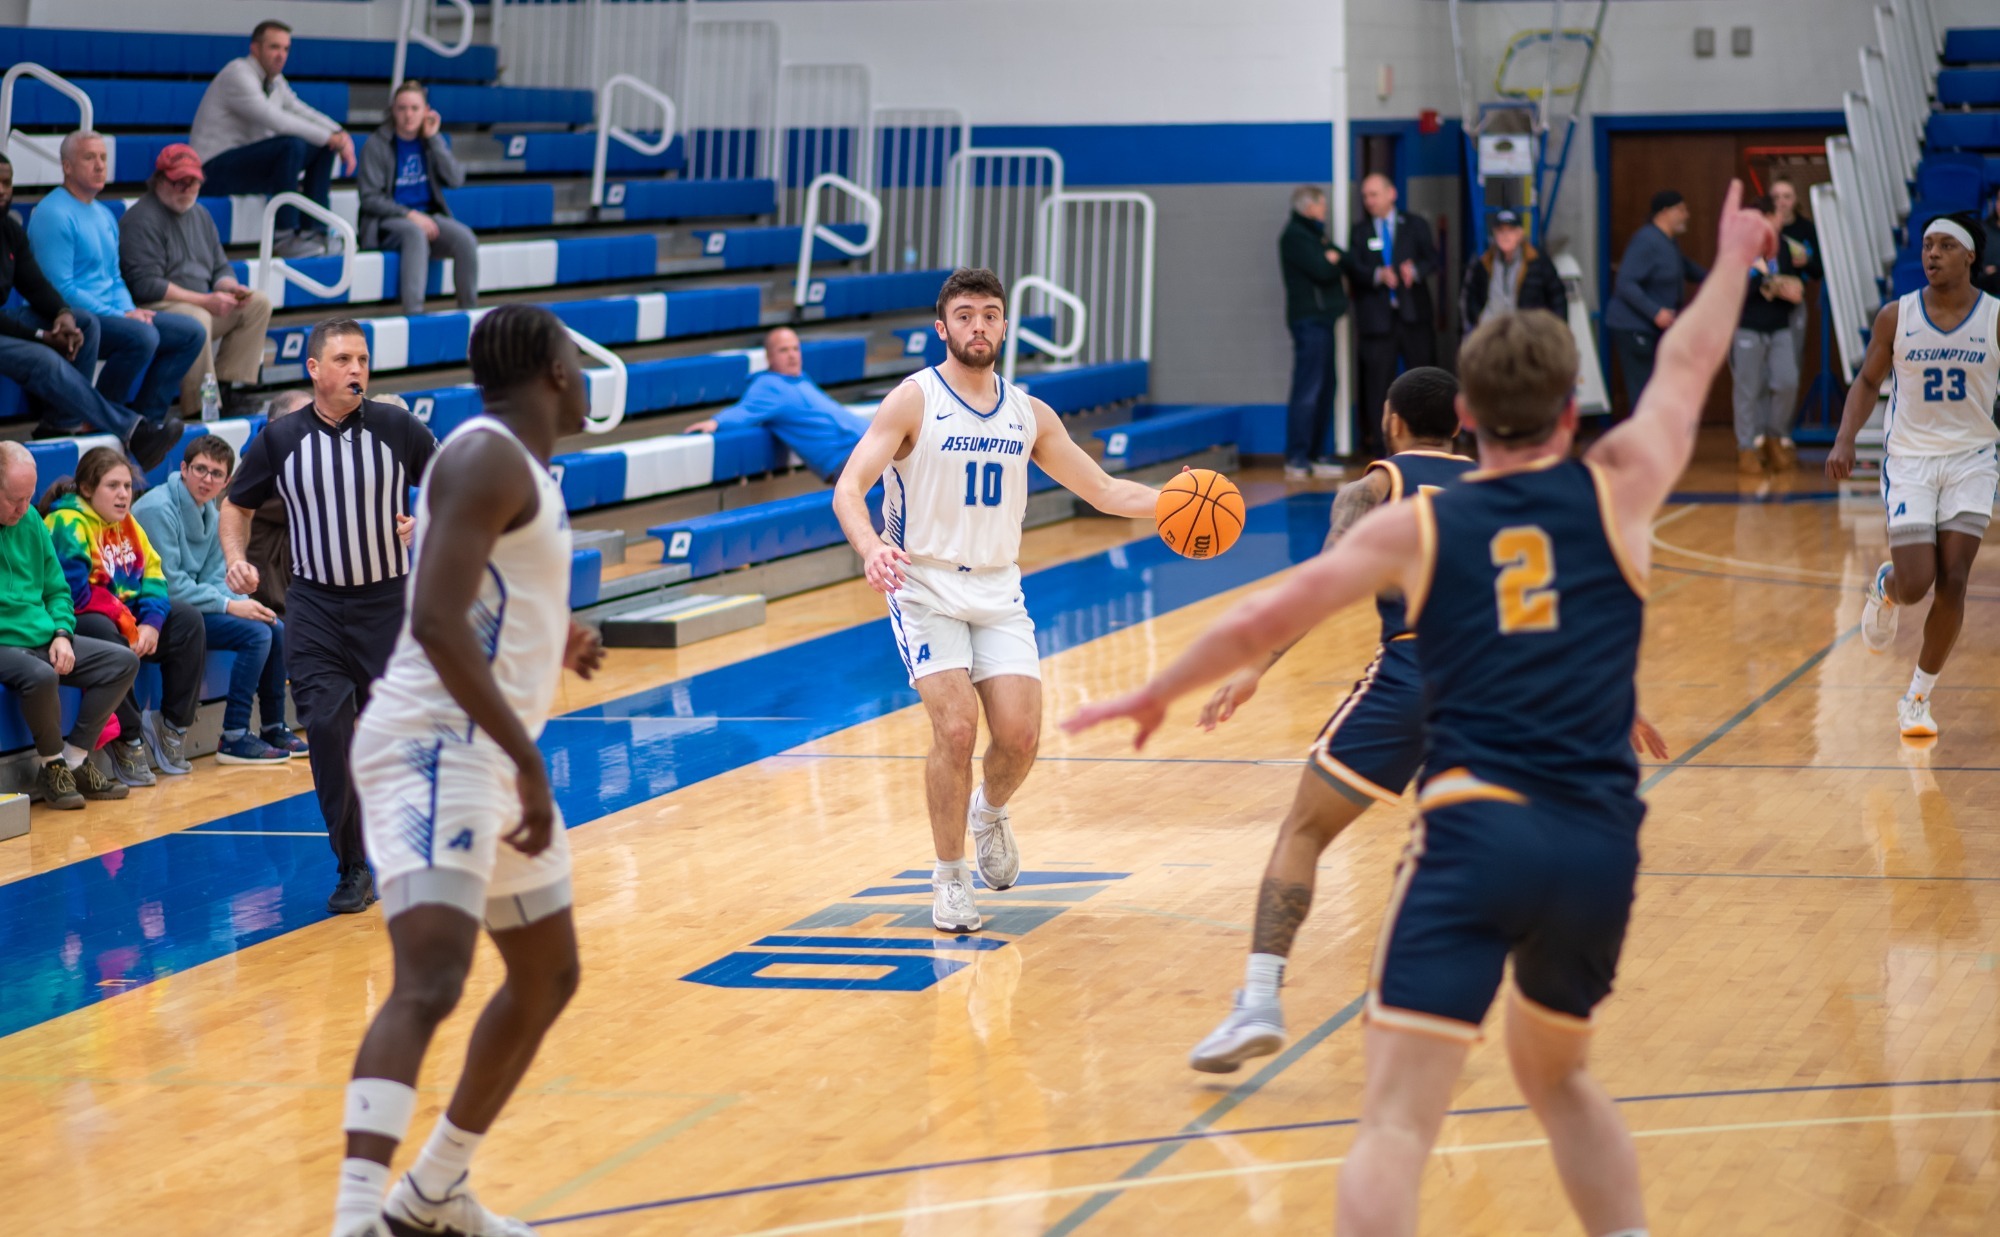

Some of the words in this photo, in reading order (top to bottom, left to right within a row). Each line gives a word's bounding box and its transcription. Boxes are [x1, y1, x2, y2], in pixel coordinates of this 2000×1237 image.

[1905, 347, 1986, 364] ASSUMPTION
[1923, 367, 1967, 402] 23
[941, 436, 1024, 456] ASSUMPTION
[964, 460, 1004, 507] 10
[1490, 524, 1560, 635] 2
[916, 643, 931, 664] A
[448, 827, 474, 852] A
